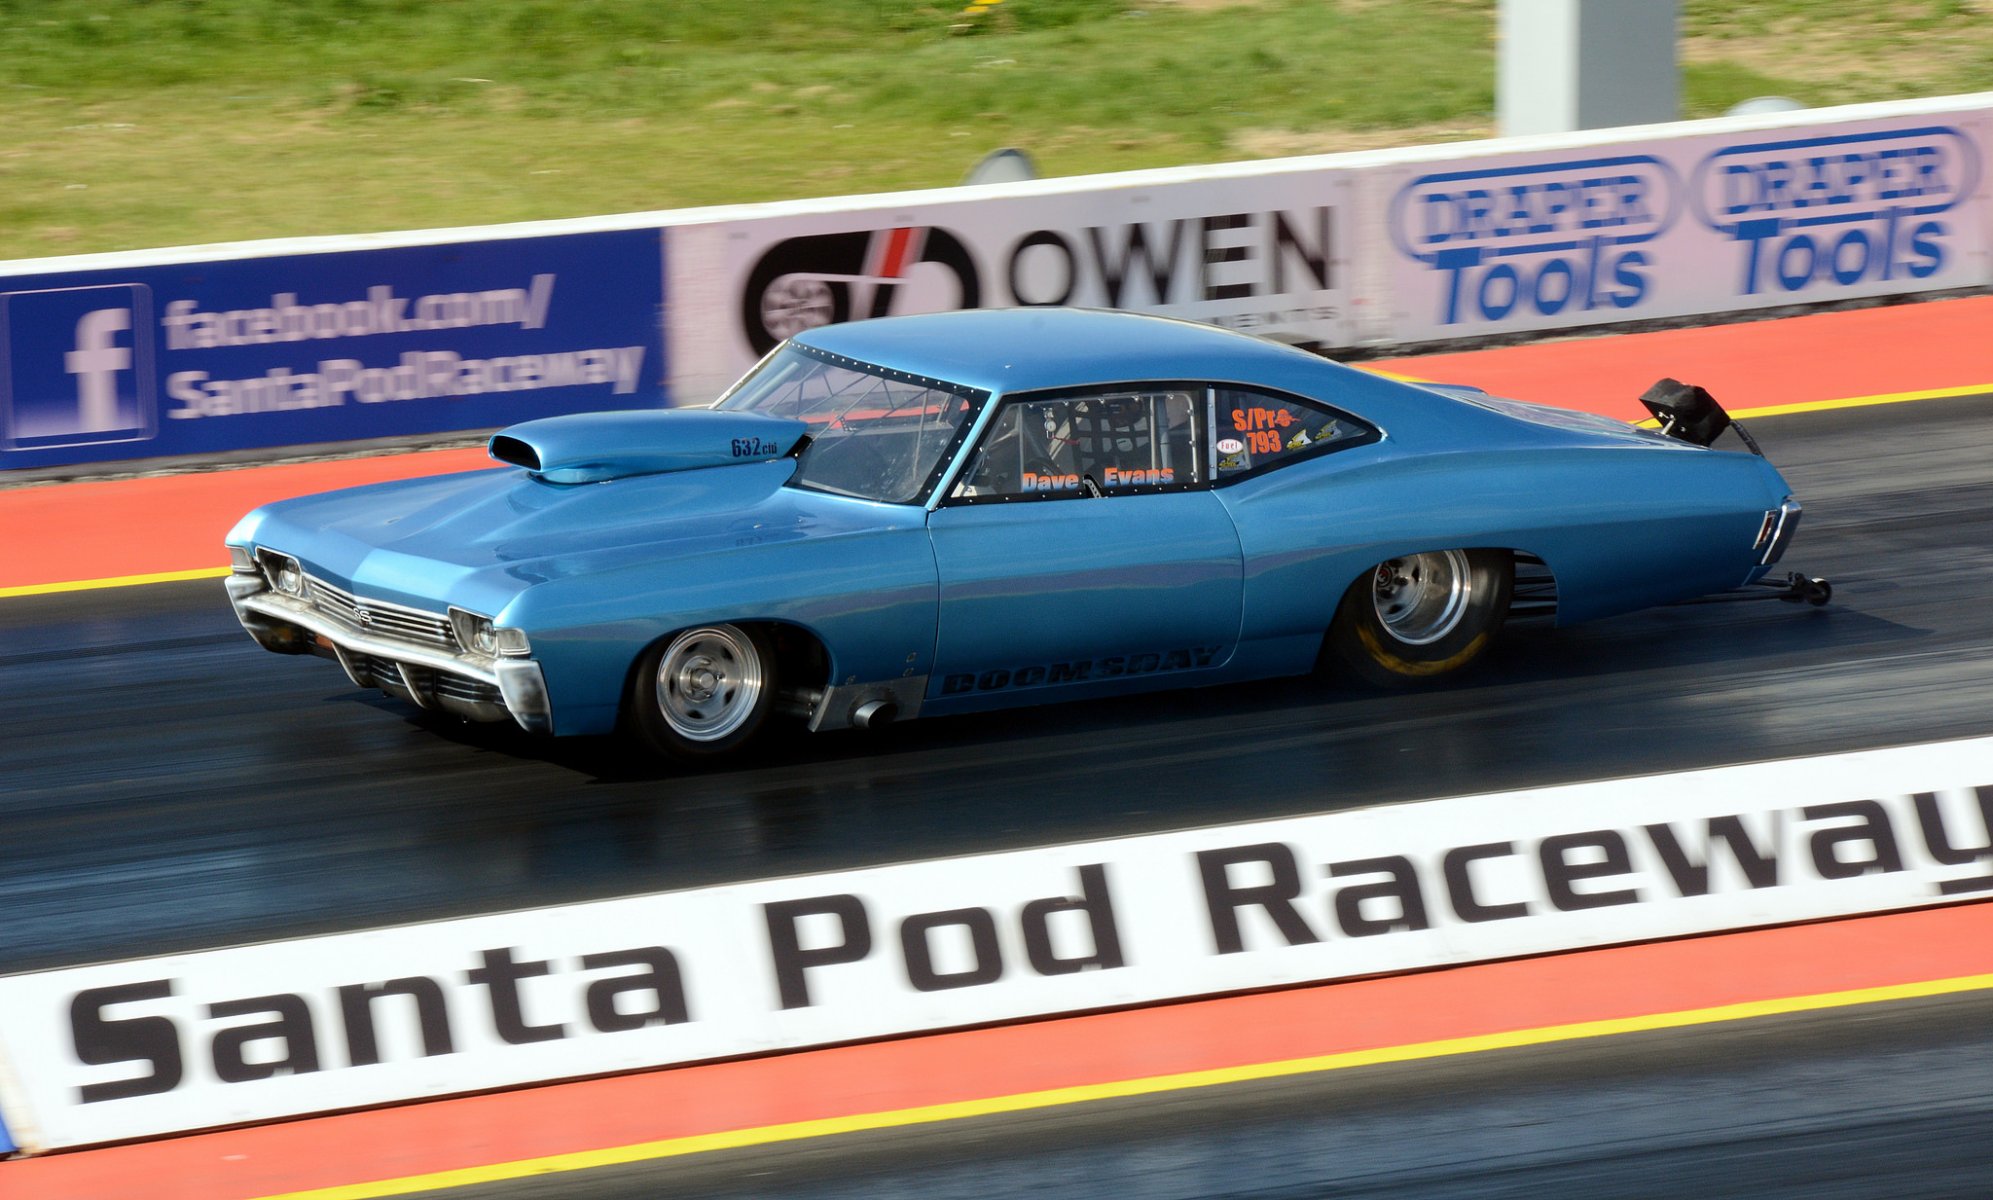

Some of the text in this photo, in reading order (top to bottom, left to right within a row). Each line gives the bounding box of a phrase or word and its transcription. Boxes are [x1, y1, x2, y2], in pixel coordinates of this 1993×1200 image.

[1418, 174, 1655, 244] DRAPER
[1719, 145, 1952, 216] DRAPER
[1007, 204, 1334, 308] OWEN
[1432, 235, 1654, 326] Tools
[1731, 205, 1952, 296] Tools
[161, 273, 556, 351] facebook.com/
[166, 345, 646, 420] SantaPodRaceway
[731, 437, 760, 457] 632
[1221, 440, 1238, 450] Fuel
[1246, 429, 1282, 455] 793
[1022, 467, 1175, 493] Dave Evans
[353, 607, 372, 622] SS
[940, 644, 1223, 696] DOOMSDAY
[65, 783, 1993, 1105] Santa Pod Raceway
